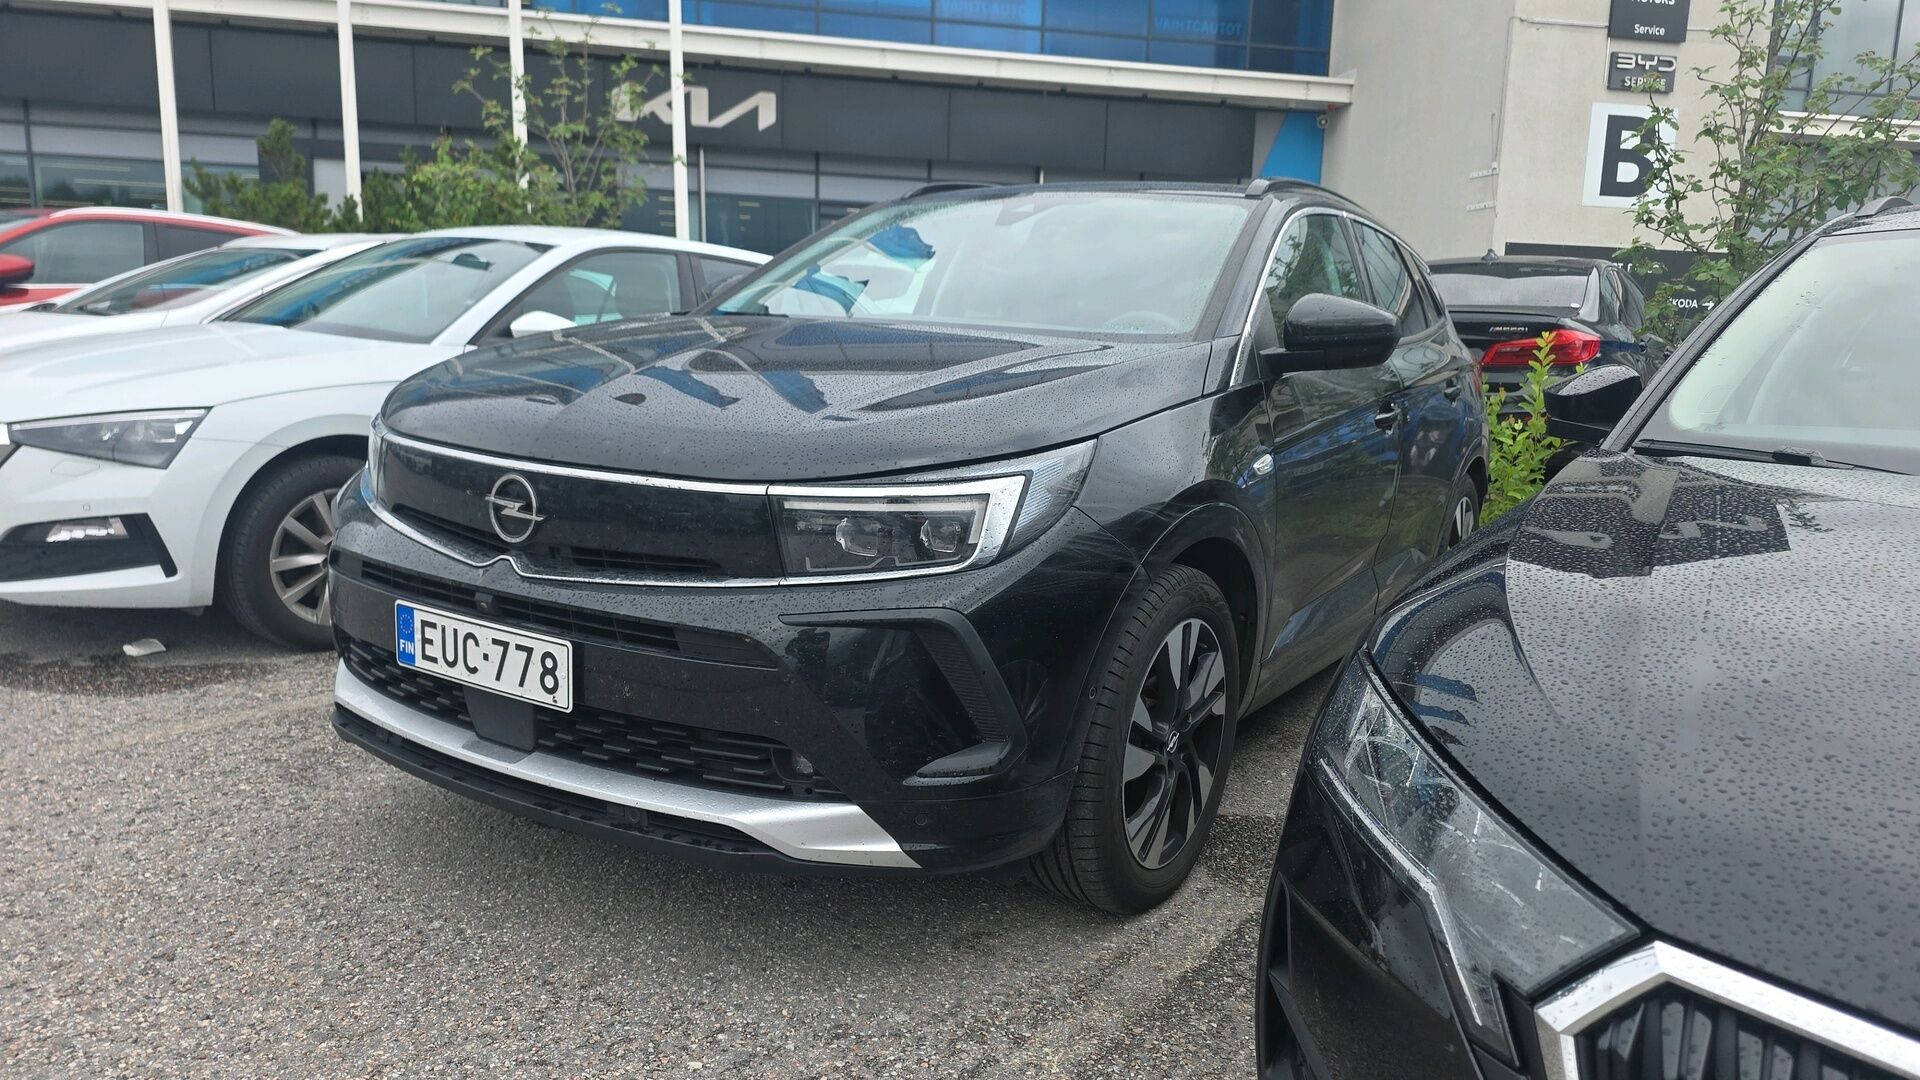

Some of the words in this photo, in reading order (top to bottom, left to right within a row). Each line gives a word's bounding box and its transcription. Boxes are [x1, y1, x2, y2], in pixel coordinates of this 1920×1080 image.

[1634, 24, 1665, 36] Service
[1617, 53, 1676, 71] BYD
[612, 85, 776, 131] KIA
[1599, 114, 1655, 197] B
[1667, 296, 1698, 309] KODA
[399, 639, 414, 655] FIN
[420, 619, 559, 695] EUC-778
